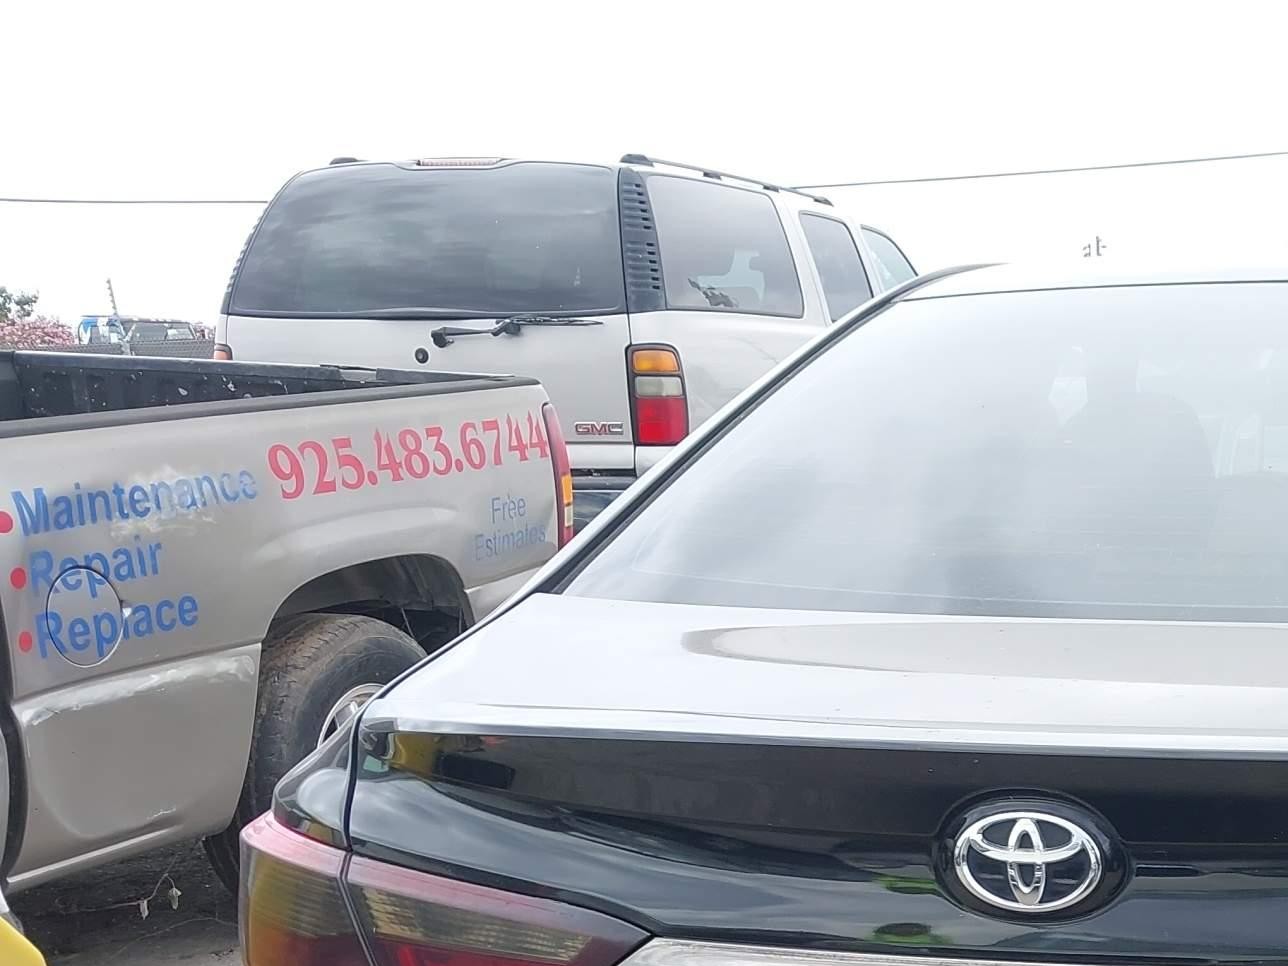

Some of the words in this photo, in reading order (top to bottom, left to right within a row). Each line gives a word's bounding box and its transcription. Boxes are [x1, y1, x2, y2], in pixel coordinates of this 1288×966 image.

[267, 410, 548, 500] 925.483.6744
[575, 421, 624, 435] GMC
[11, 470, 257, 536] Maintenance
[491, 496, 526, 524] Free
[28, 534, 162, 599] Repair
[475, 526, 545, 561] Estimates
[34, 595, 199, 659] Replace
